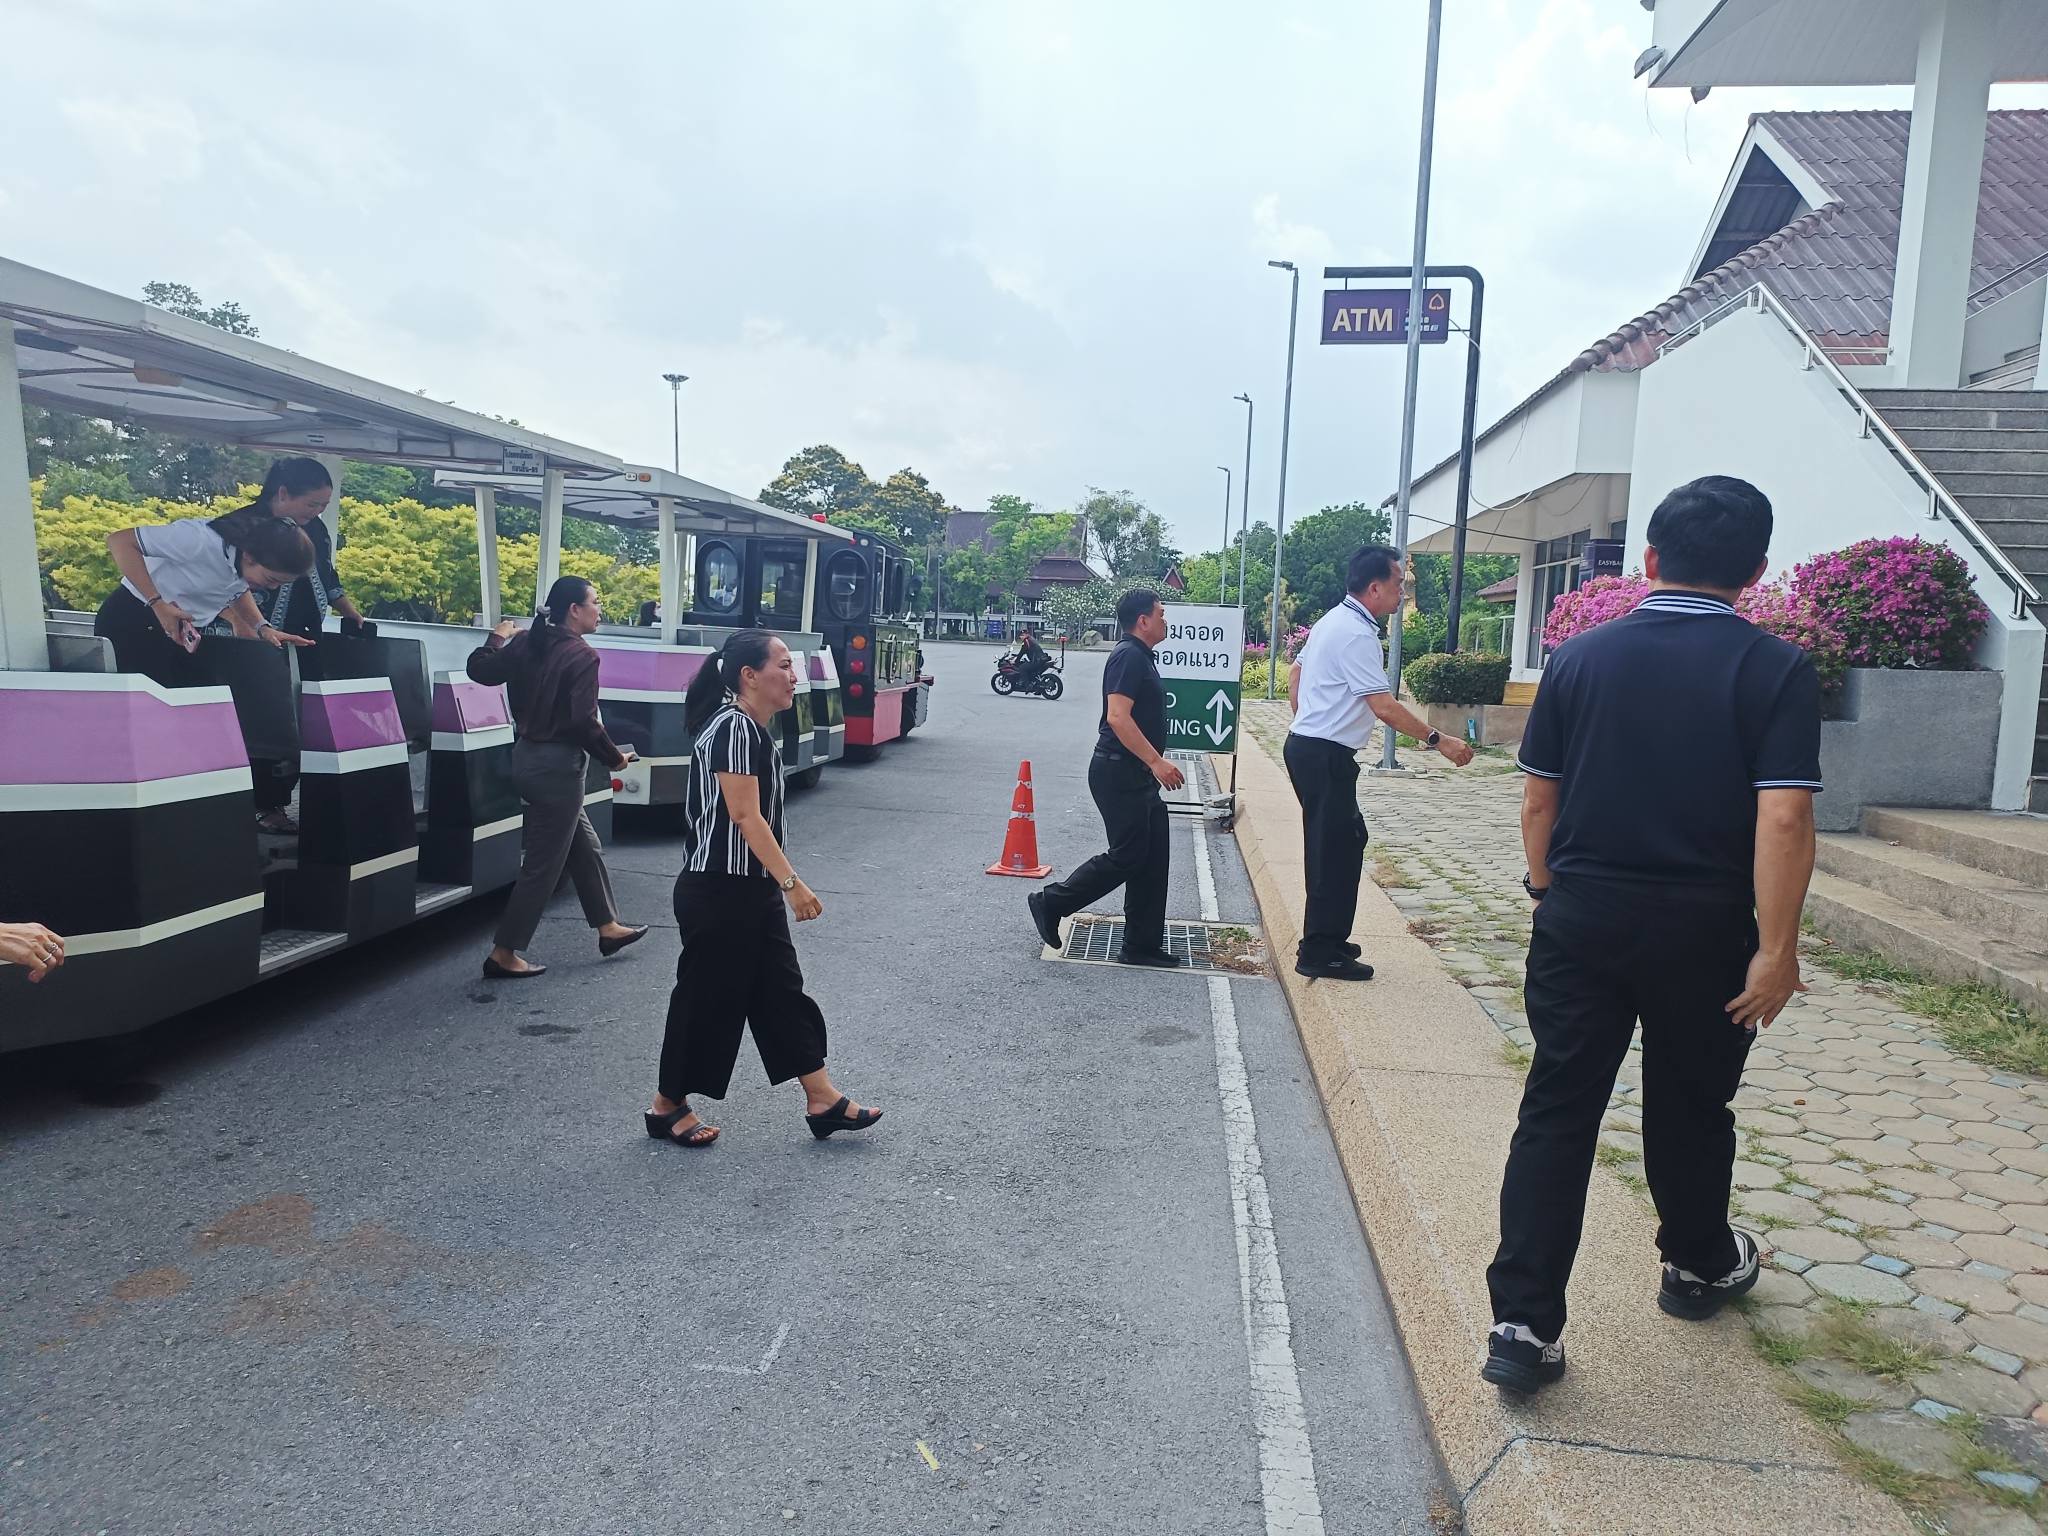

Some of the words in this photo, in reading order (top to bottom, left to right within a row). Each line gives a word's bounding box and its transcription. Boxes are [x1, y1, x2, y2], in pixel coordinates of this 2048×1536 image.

[1331, 308, 1393, 332] ATM
[1152, 650, 1230, 668] ลอดแนว
[1166, 718, 1201, 736] ING
